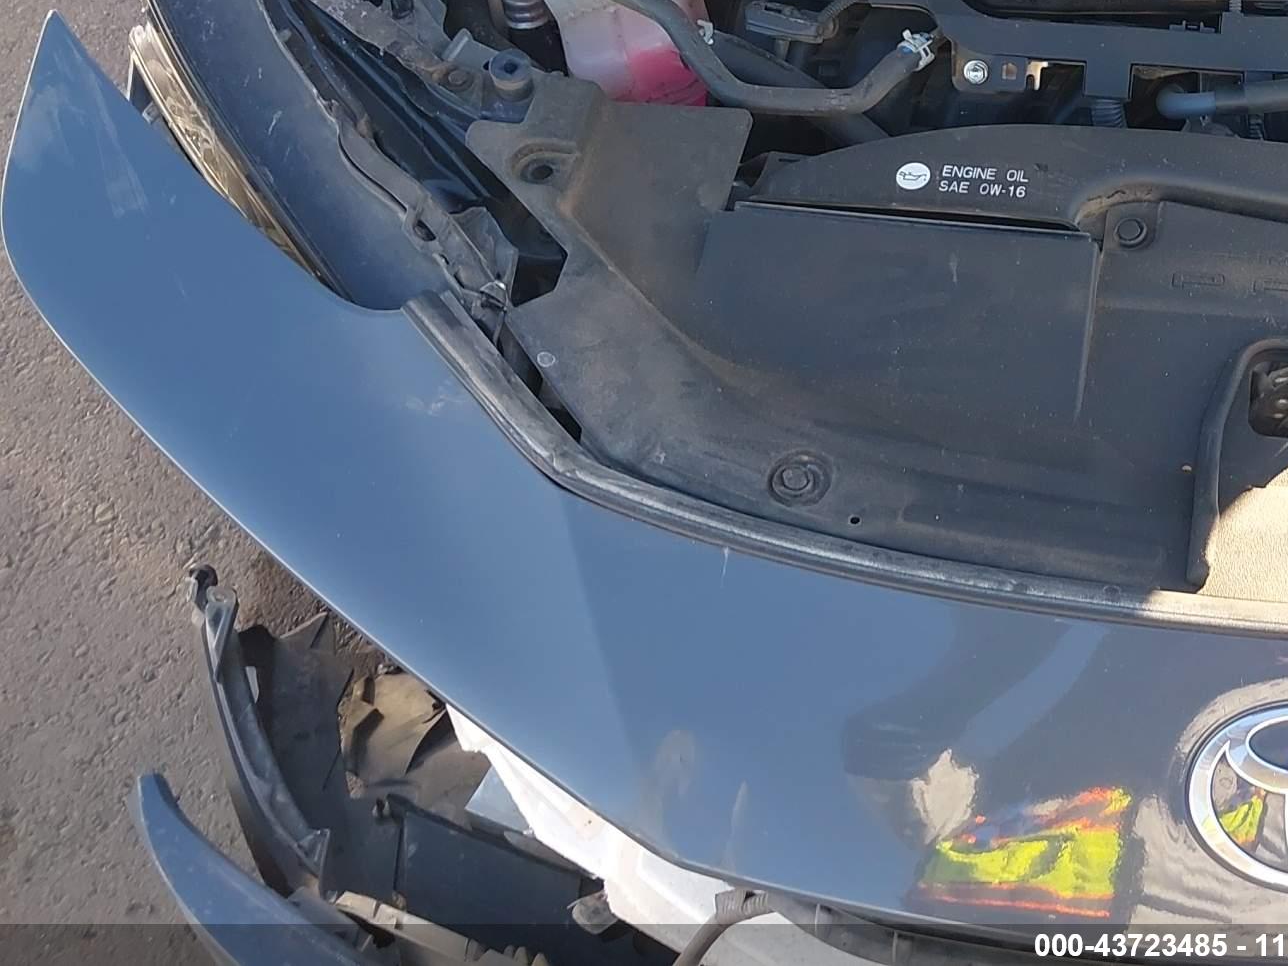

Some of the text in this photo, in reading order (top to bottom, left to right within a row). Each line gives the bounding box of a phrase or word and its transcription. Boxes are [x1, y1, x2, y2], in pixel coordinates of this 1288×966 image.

[941, 164, 1030, 183] ENGINE OIL
[938, 180, 1027, 198] SAE 0W-16
